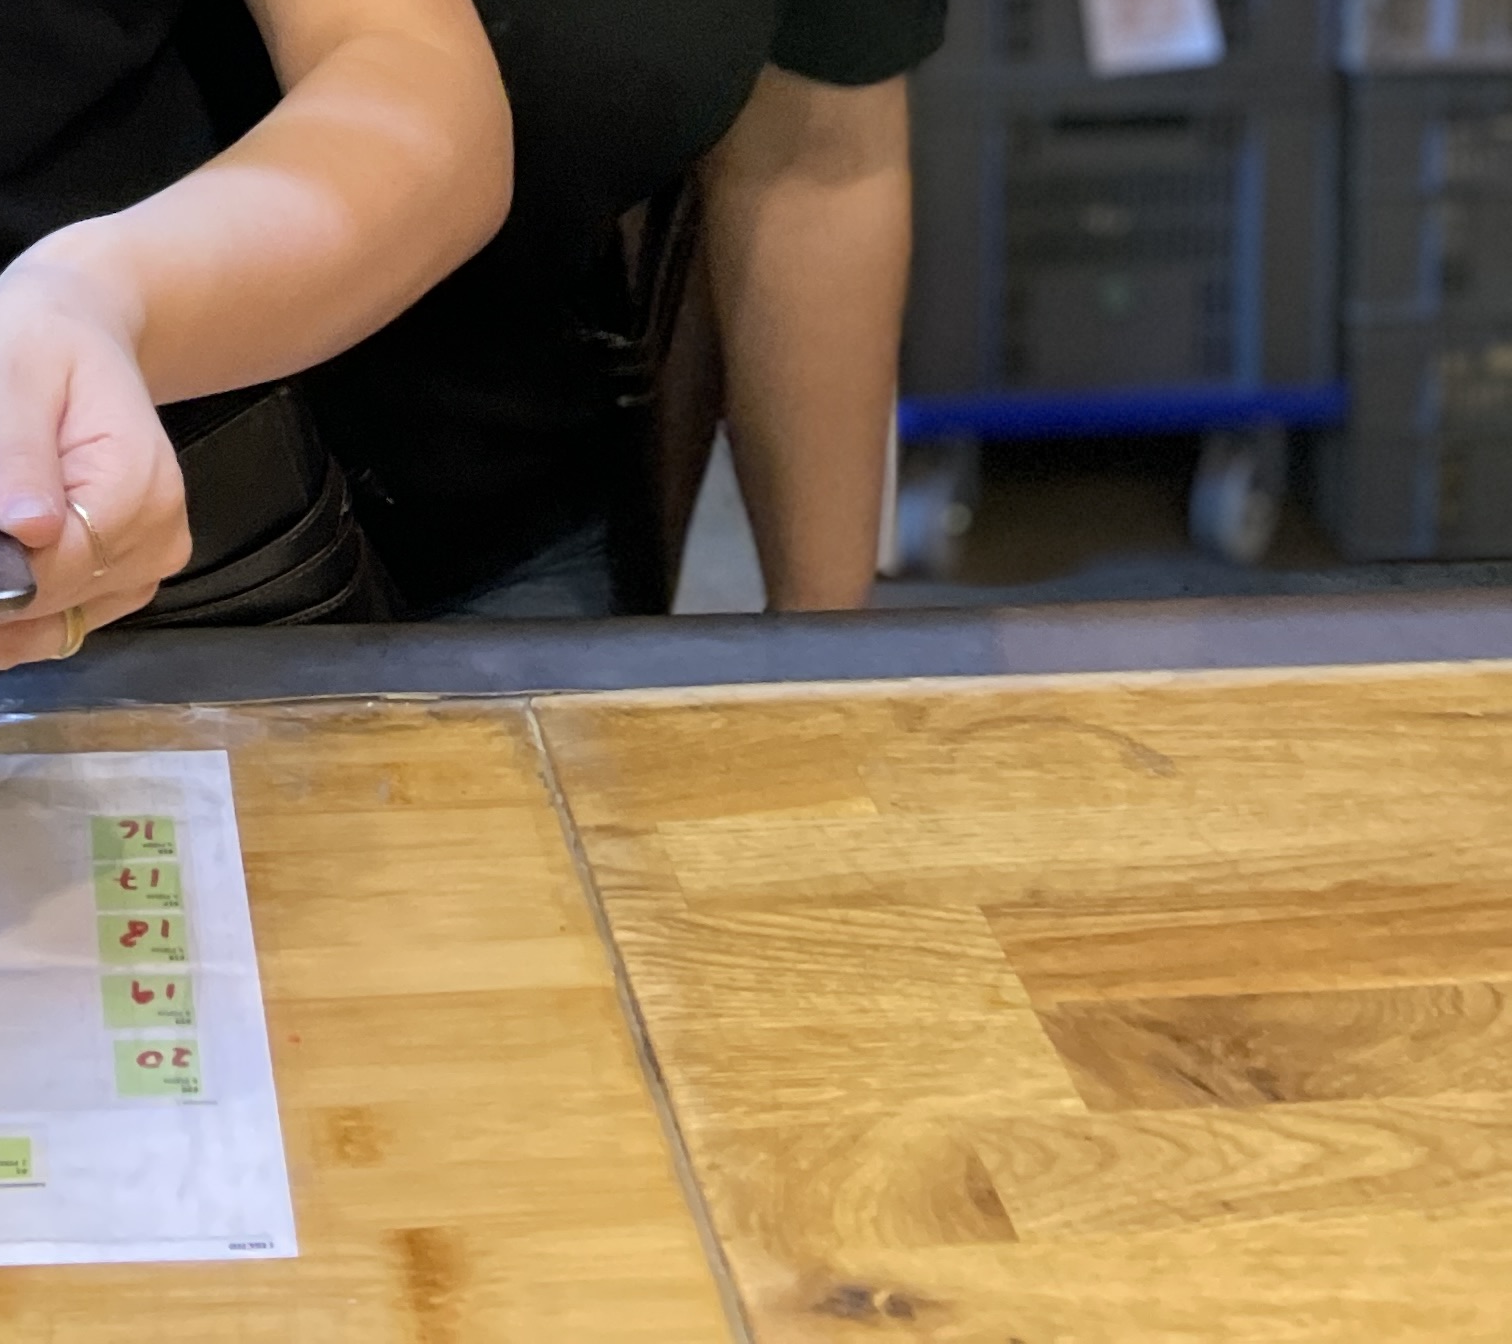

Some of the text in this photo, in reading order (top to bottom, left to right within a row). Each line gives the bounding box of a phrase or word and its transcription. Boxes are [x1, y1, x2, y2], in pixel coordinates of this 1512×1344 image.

[119, 820, 154, 840] 16
[112, 868, 160, 890] 17
[119, 918, 170, 947] 18
[131, 980, 176, 1004] 19
[136, 1047, 190, 1067] 20
